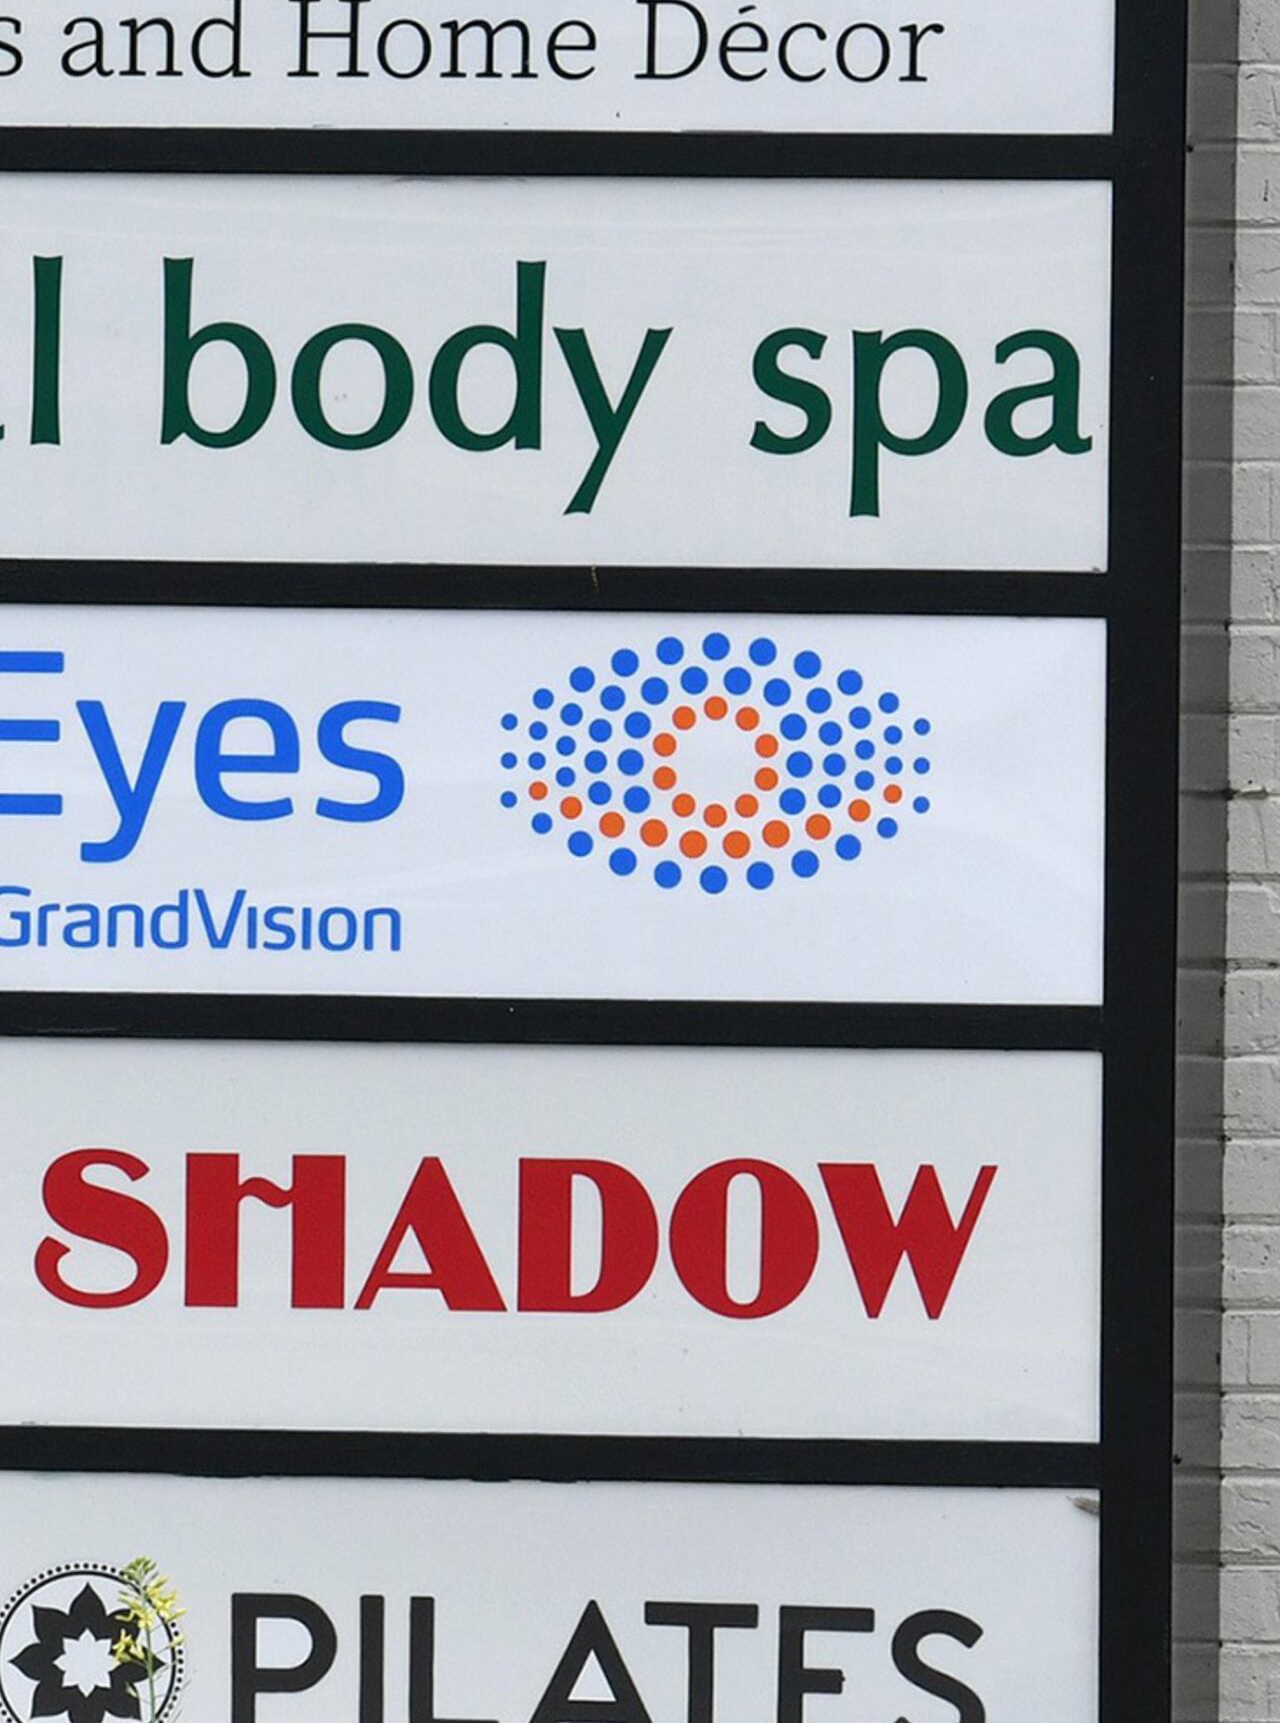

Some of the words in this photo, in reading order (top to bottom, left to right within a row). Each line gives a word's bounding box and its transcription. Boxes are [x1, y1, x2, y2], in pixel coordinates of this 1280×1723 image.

[160, 257, 673, 515] body
[750, 328, 1092, 517] spa
[34, 1149, 997, 1319] SHADOW
